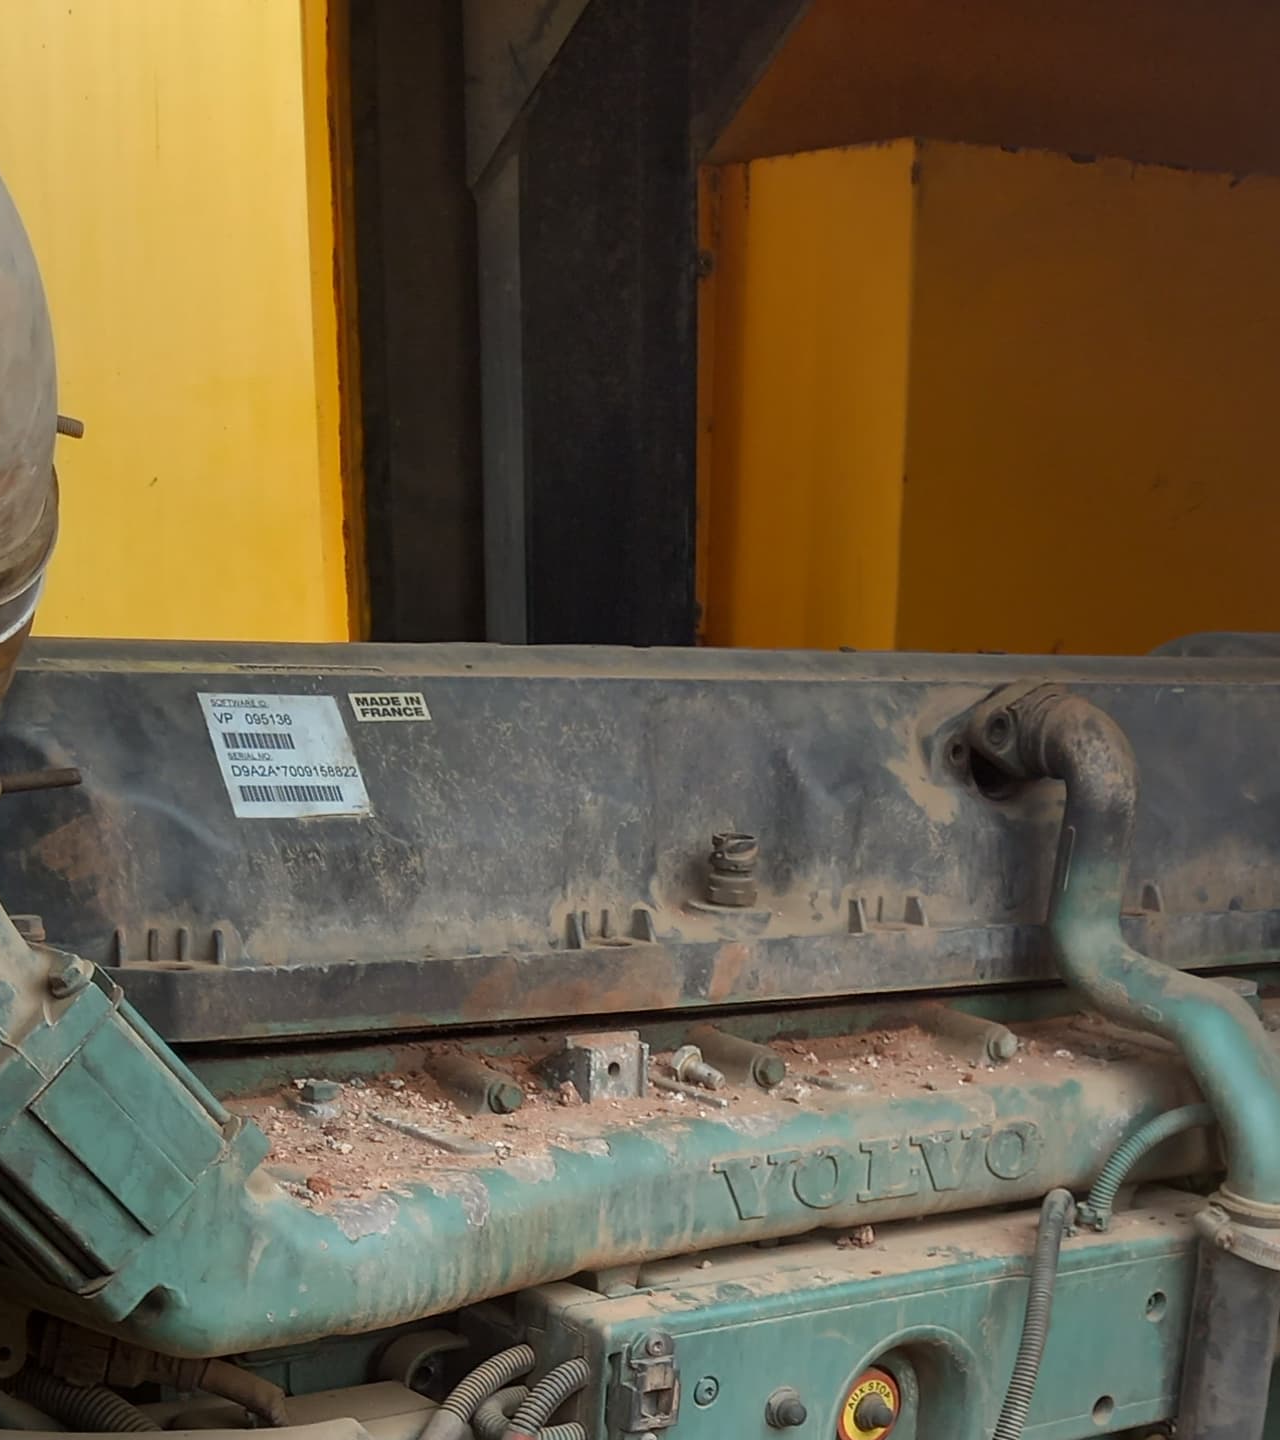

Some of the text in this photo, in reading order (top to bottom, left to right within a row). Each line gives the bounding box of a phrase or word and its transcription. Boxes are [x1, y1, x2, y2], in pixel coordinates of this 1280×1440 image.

[354, 695, 422, 707] MADE IN
[213, 712, 233, 724] VP
[360, 707, 425, 718] FRANCE
[712, 1121, 1039, 1220] VOLVO
[848, 1382, 891, 1410] AUX STOP
